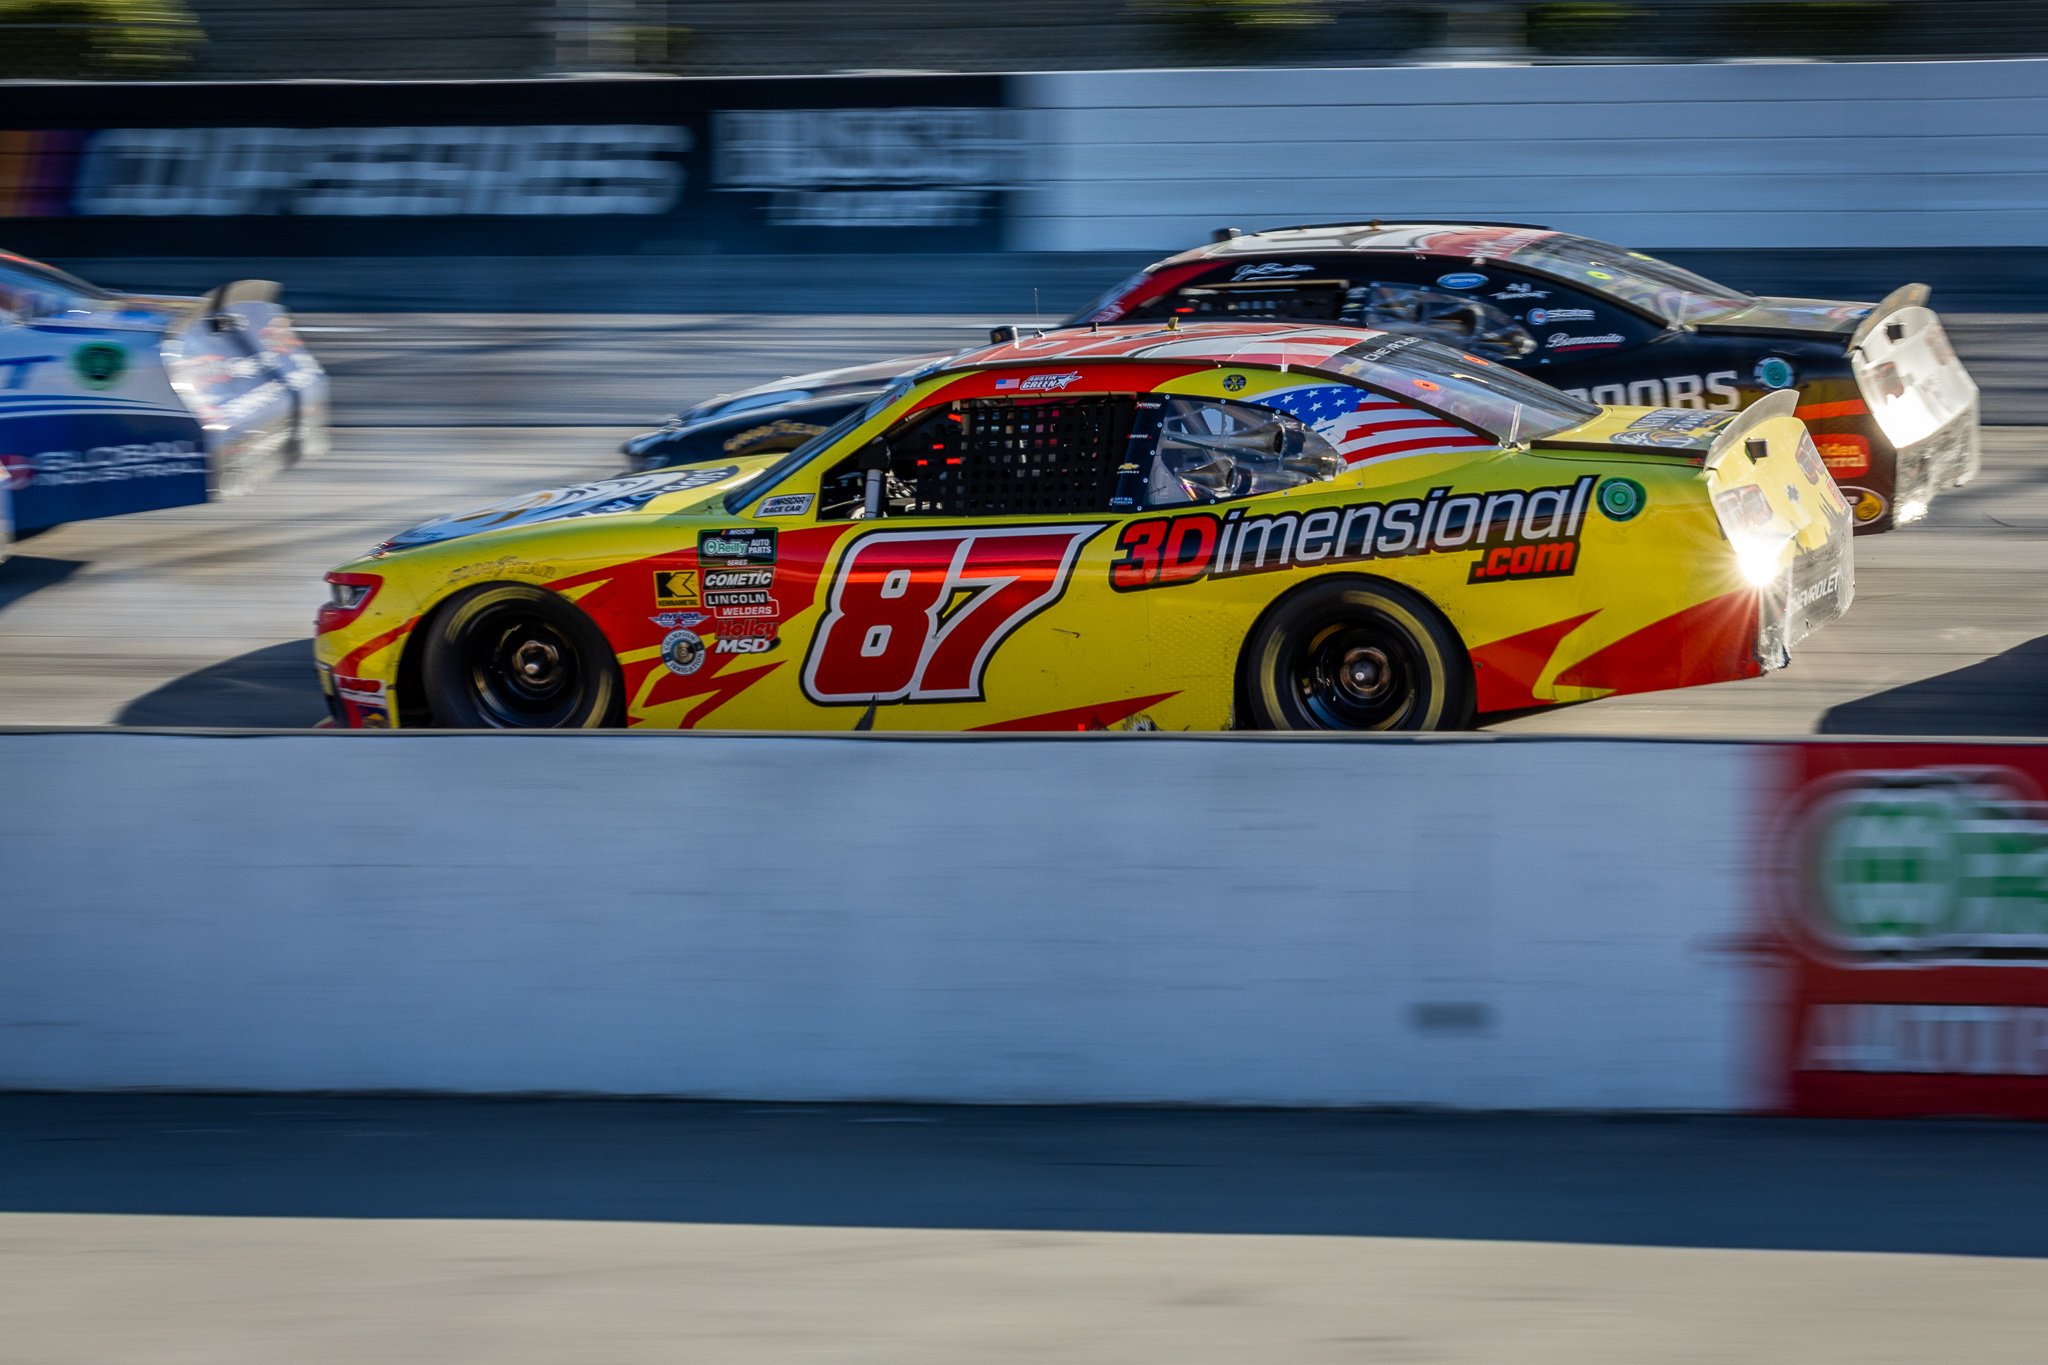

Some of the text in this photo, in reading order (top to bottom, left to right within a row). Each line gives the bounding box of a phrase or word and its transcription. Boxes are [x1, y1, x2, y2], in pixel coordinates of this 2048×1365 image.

[1561, 370, 1739, 411] OORS
[776, 496, 806, 504] NASCAR
[1114, 477, 1594, 588] 3Dimensional
[704, 538, 748, 556] O'Reilly
[748, 546, 772, 554] PARTS
[750, 538, 770, 546] AUTO
[1475, 541, 1575, 577] .com
[704, 571, 772, 587] COMETIC
[658, 599, 699, 607] KENNAMETAL
[707, 593, 765, 605] LINCOLN
[722, 605, 773, 616] WELDERS
[803, 524, 1107, 702] 87
[715, 619, 778, 641] Holley
[714, 638, 771, 654] MSD
